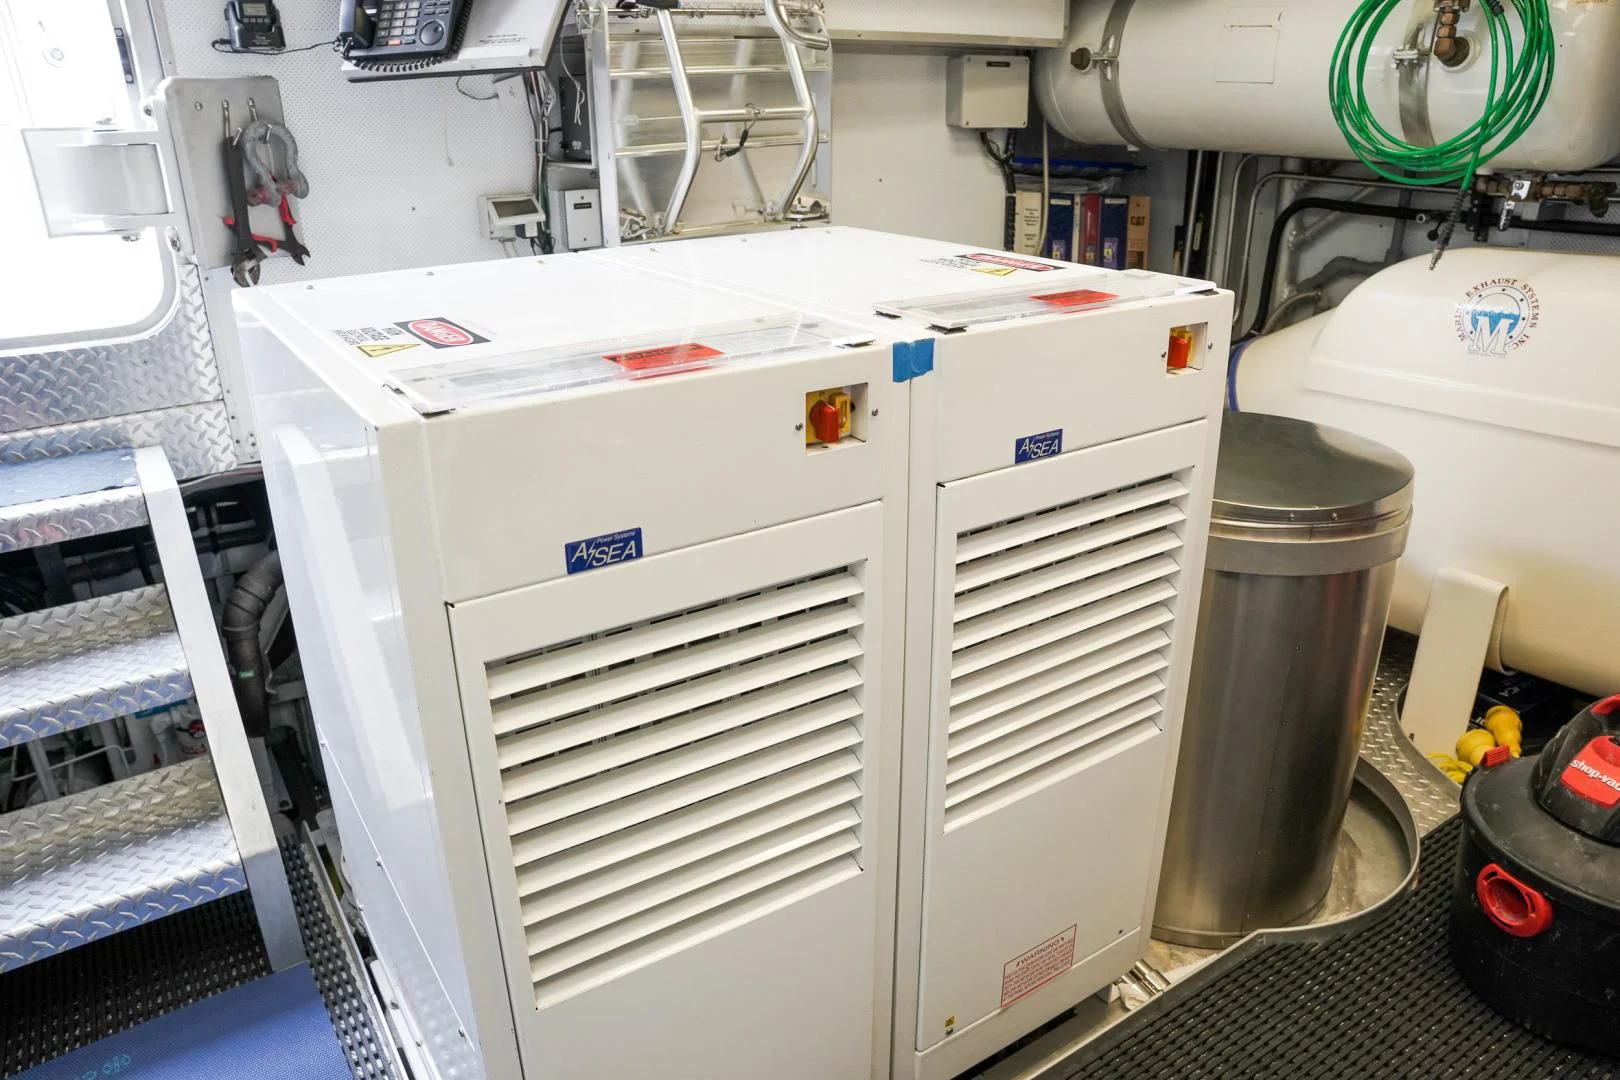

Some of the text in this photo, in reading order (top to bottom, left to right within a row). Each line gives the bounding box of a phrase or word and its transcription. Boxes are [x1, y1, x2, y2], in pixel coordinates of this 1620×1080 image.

[1130, 216, 1146, 225] CAT
[1465, 278, 1518, 298] EXHAUST
[1520, 283, 1540, 329] SYSTEMS
[415, 322, 468, 343] DANGER
[1512, 333, 1531, 350] INC
[596, 530, 636, 545] Power Systems
